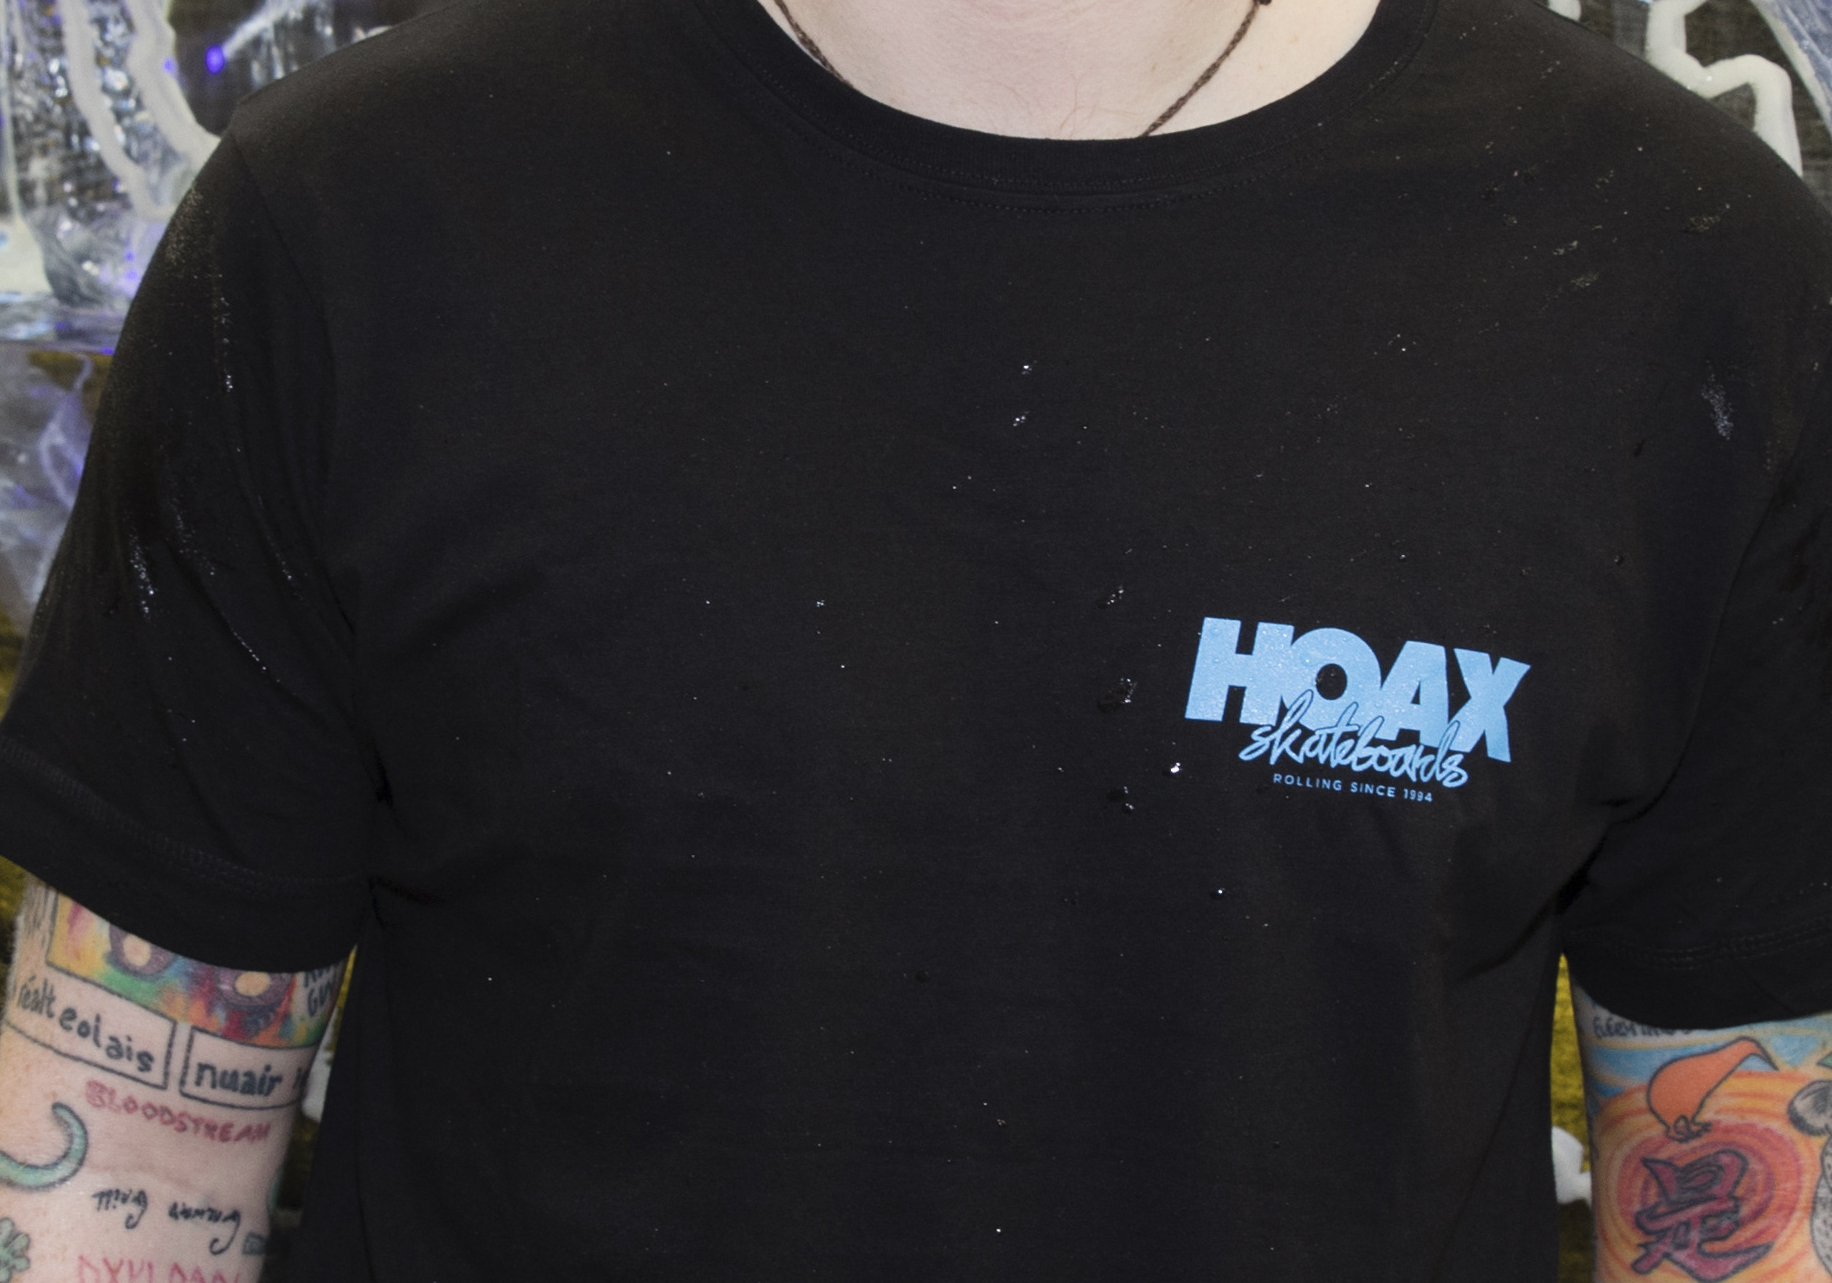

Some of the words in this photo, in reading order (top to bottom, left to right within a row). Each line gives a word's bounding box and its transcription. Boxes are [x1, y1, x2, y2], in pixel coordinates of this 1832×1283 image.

[1185, 617, 1531, 763] HOAX
[1238, 689, 1469, 788] skateboards
[1273, 773, 1343, 792] ROLLING
[1350, 781, 1396, 798] SINCE
[1403, 787, 1433, 803] 1994
[59, 1007, 155, 1072] eolais
